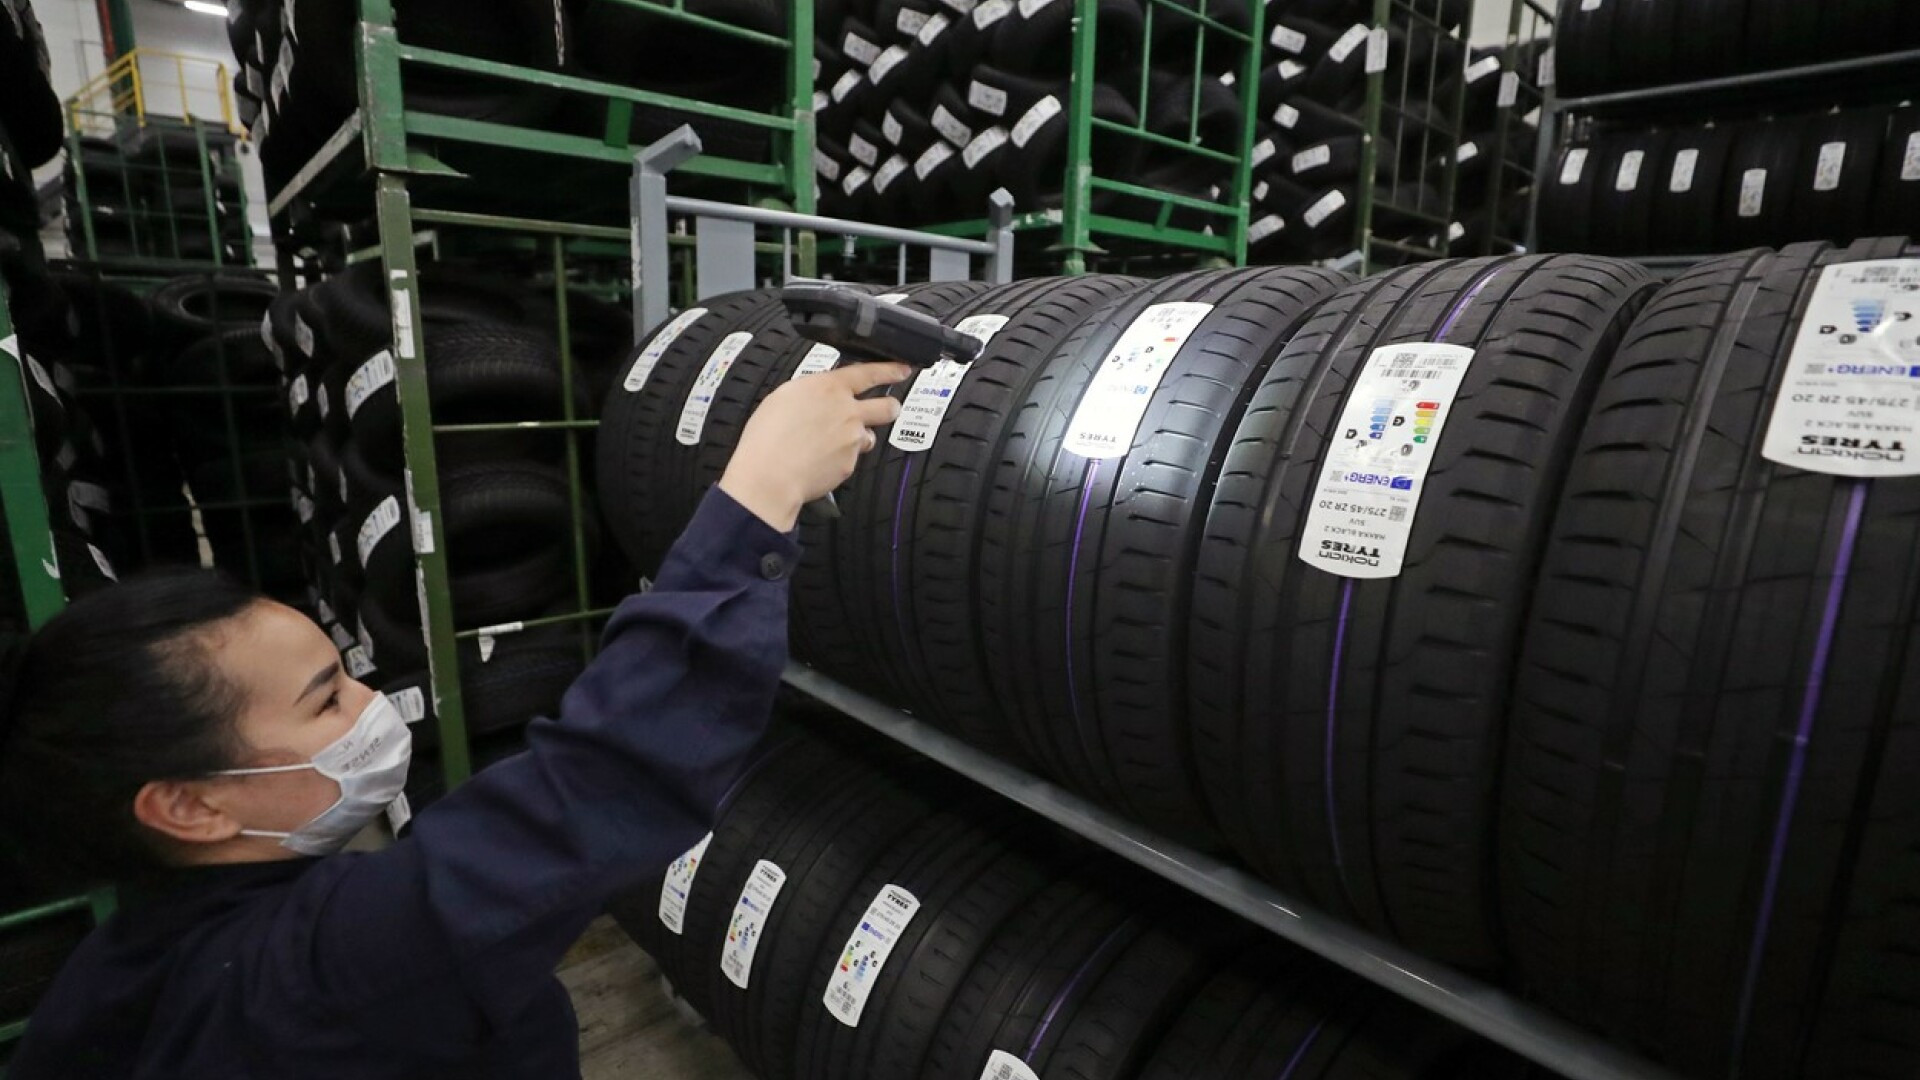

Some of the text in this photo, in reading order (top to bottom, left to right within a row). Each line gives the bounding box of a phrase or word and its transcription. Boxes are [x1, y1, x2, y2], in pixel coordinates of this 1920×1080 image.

[1792, 394, 1814, 403] 20
[1819, 394, 1841, 404] ZR
[1801, 435, 1905, 451] TYRES
[1319, 500, 1387, 517] 275/45 ZR 20
[1321, 540, 1380, 558] TYRES
